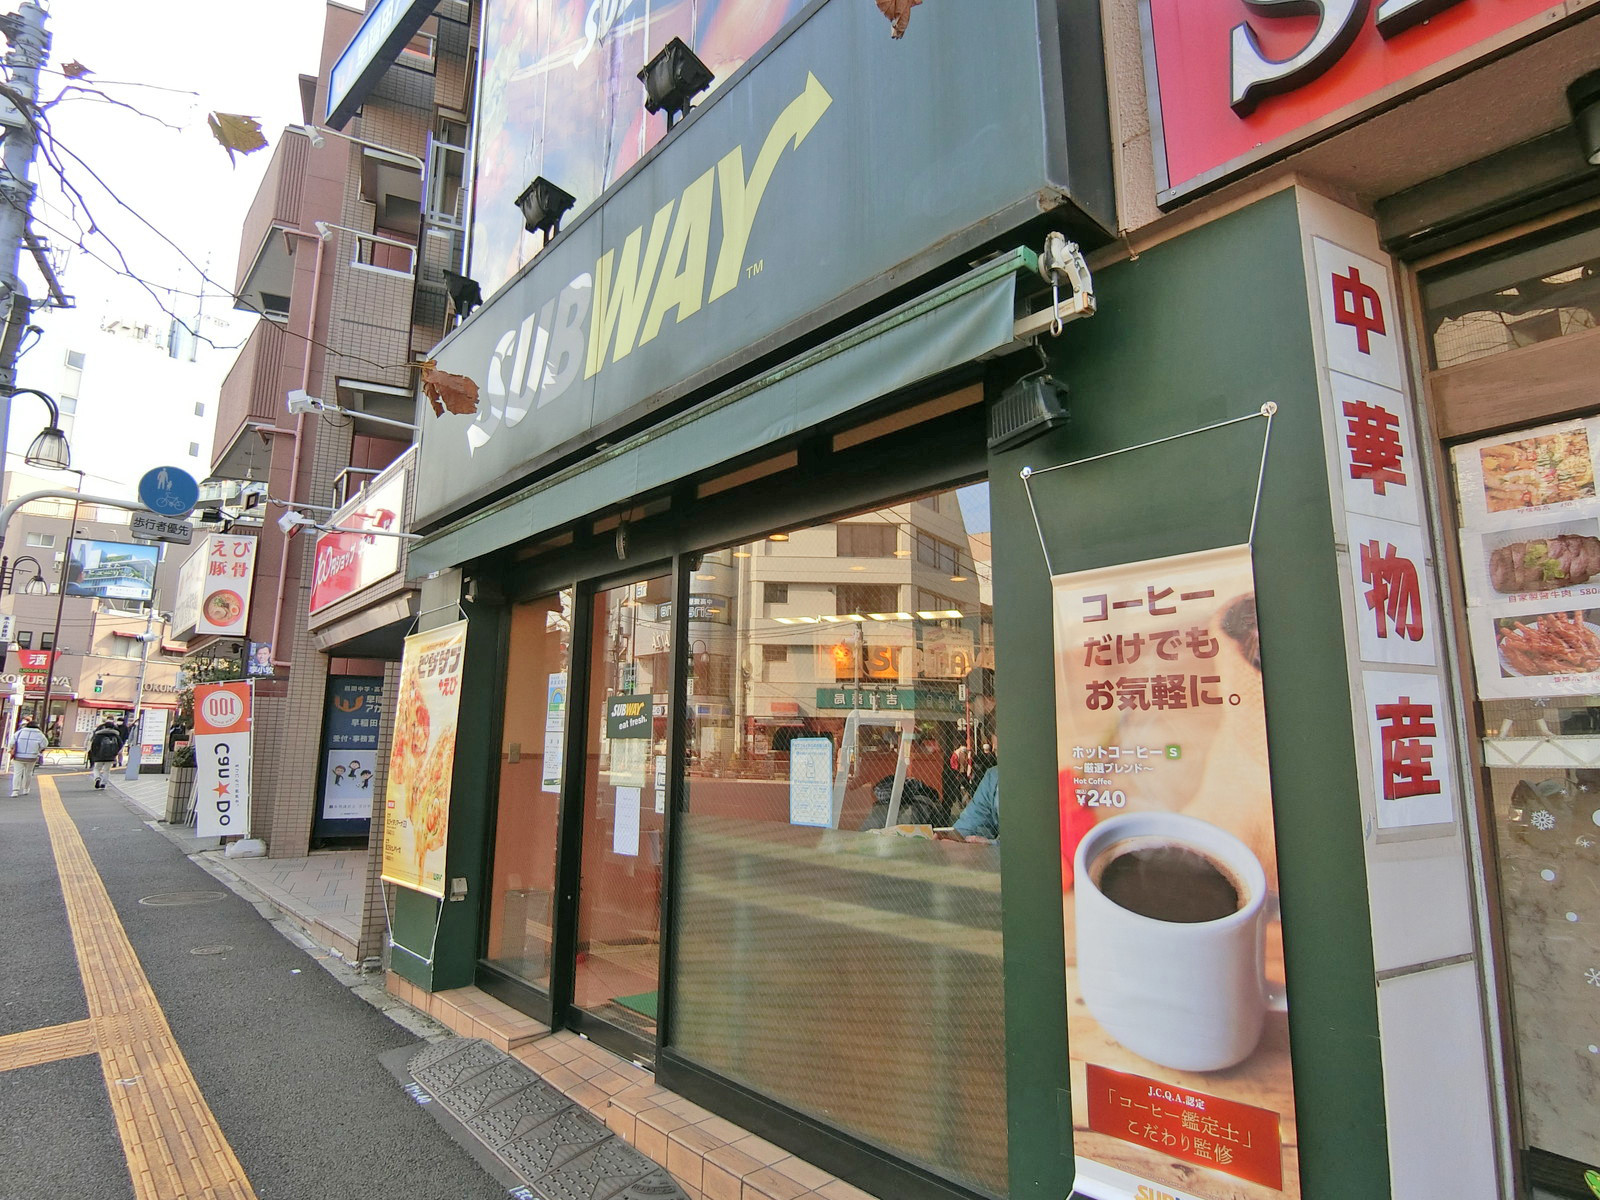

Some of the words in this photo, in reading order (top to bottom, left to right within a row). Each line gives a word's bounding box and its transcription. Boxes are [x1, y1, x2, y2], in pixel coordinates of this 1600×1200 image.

[467, 70, 833, 459] SUBWAY
[133, 516, 190, 537] 歩行者優先
[1331, 265, 1442, 802] 中華物産
[211, 540, 253, 558] えび
[208, 560, 249, 578] 豚骨
[1082, 585, 1216, 623] コーヒー
[1083, 626, 1220, 668] だけでも
[29, 654, 48, 666] 酒
[1085, 674, 1242, 712] お気軽に。
[611, 702, 645, 717] SUBWAY
[619, 719, 629, 730] eat
[630, 714, 648, 728] fresh.
[1072, 745, 1162, 759] ホットコーヒー
[1169, 747, 1178, 757] S
[1073, 777, 1087, 785] Hot
[1088, 777, 1112, 786] Coffee
[1076, 789, 1126, 808] ¥240
[1106, 1088, 1253, 1149] 「コーヒー鑑定士」
[1127, 1118, 1234, 1166] こだわり監修
